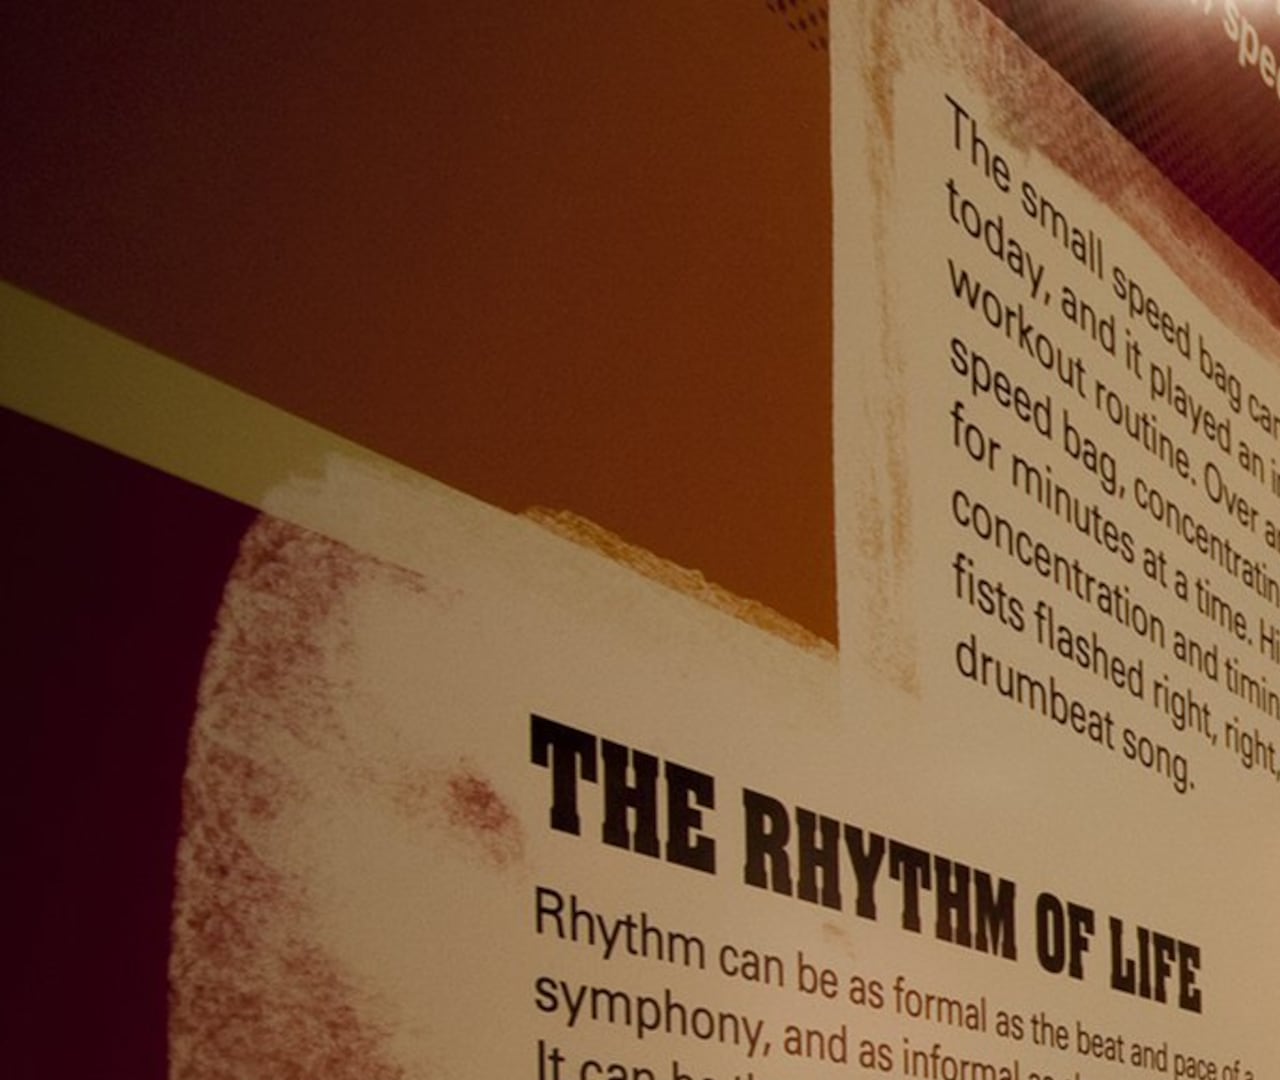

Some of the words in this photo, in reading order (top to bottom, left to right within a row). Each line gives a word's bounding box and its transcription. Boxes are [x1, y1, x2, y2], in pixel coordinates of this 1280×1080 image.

[944, 94, 1011, 193] The
[1021, 181, 1103, 280] small
[1113, 267, 1191, 361] speed
[1199, 335, 1242, 414] bag
[946, 178, 1051, 306] today,
[1061, 286, 1116, 357] and
[1150, 363, 1231, 455] played
[948, 259, 1086, 399] workout
[1096, 381, 1196, 485] routine.
[1204, 461, 1259, 531] Over
[950, 338, 1052, 440] speed
[1063, 410, 1125, 499] bag,
[950, 401, 1002, 471] for
[1012, 455, 1135, 564] minutes
[1195, 578, 1252, 645] time.
[952, 490, 1165, 648] concentration
[1173, 631, 1218, 682] and
[952, 552, 1025, 633] fists
[1033, 600, 1144, 700] flashed
[1153, 675, 1217, 745] right,
[1225, 717, 1280, 781] right,
[956, 633, 1115, 751] drumbeat
[1123, 728, 1195, 795] song.
[530, 714, 717, 875] THE
[741, 786, 1019, 961] RHYTHM
[1035, 890, 1095, 980] OF
[1108, 915, 1204, 1014] LIFE
[535, 886, 705, 970] Rhythm
[719, 945, 784, 987] can
[798, 951, 838, 999] be
[849, 976, 884, 1009] as
[893, 975, 986, 1032] formal
[1030, 1012, 1069, 1051] the
[1076, 1021, 1125, 1064] beat
[1130, 1043, 1168, 1073] and
[535, 976, 771, 1058] symphony,
[784, 1024, 847, 1064] and
[858, 1039, 893, 1072] as
